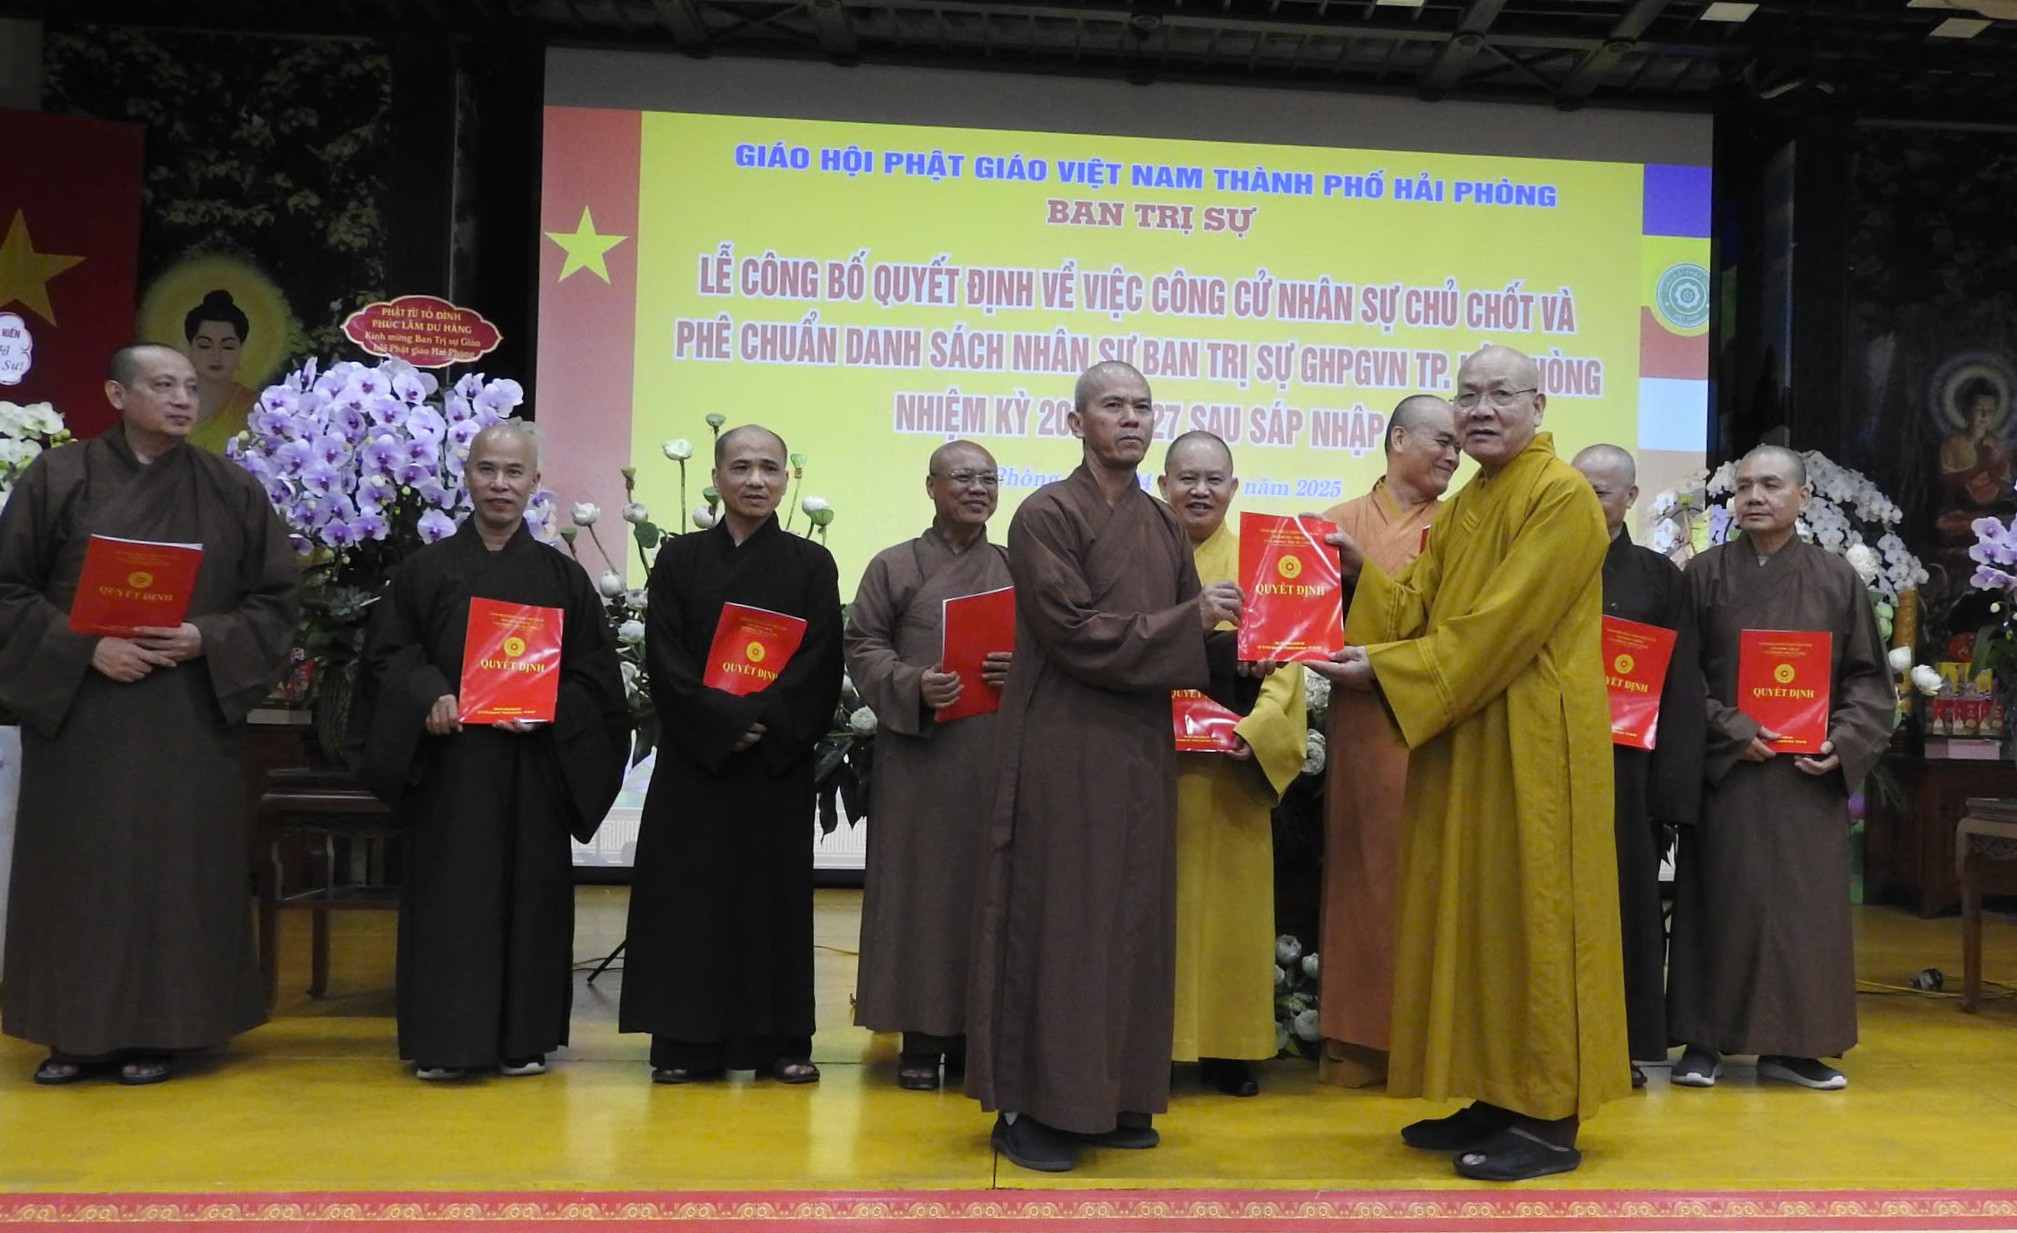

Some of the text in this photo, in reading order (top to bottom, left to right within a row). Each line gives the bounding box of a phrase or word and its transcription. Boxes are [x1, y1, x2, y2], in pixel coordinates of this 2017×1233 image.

[735, 142, 1556, 207] GIÁO HỘI PHẬT GIÁO VIỆT NAM THÀNH PHỐ HẢI PHÒNG
[1047, 200, 1257, 238] BAN TRỊ SỰ
[700, 244, 1575, 332] LỄ CÔNG BỐ QUYẾT ĐỊNH VỀ VIỆC CÔNG CỬ NHÂN SỰ CHỦ CHỐT VÀ
[372, 318, 399, 328] PHÚC
[676, 315, 731, 359] PHÊ
[741, 311, 837, 363] CHUẨN
[846, 328, 922, 366] DANH
[930, 325, 1003, 369] SÁCH
[1013, 328, 1089, 372] NHÂN
[1143, 340, 1199, 377] BAN
[1207, 343, 1248, 387] TRỊ
[1256, 343, 1294, 389] SỰ
[1301, 346, 1407, 387] GHPGVN
[1416, 352, 1450, 389] TP.
[896, 388, 987, 440] NHIỆM
[996, 390, 1031, 435] KỲ
[1038, 400, 1072, 436] 20
[1190, 405, 1241, 442] SAU
[1250, 401, 1303, 445] SÁP
[1312, 406, 1385, 456] NHẬP
[1243, 479, 1289, 496] năm
[1296, 479, 1342, 498] 2025
[1255, 582, 1325, 598] QUYẾT ĐỊNH
[480, 658, 518, 672] QUYẾT
[722, 661, 756, 676] QUYẾT
[1753, 687, 1814, 700] QUYẾT ĐỊNH
